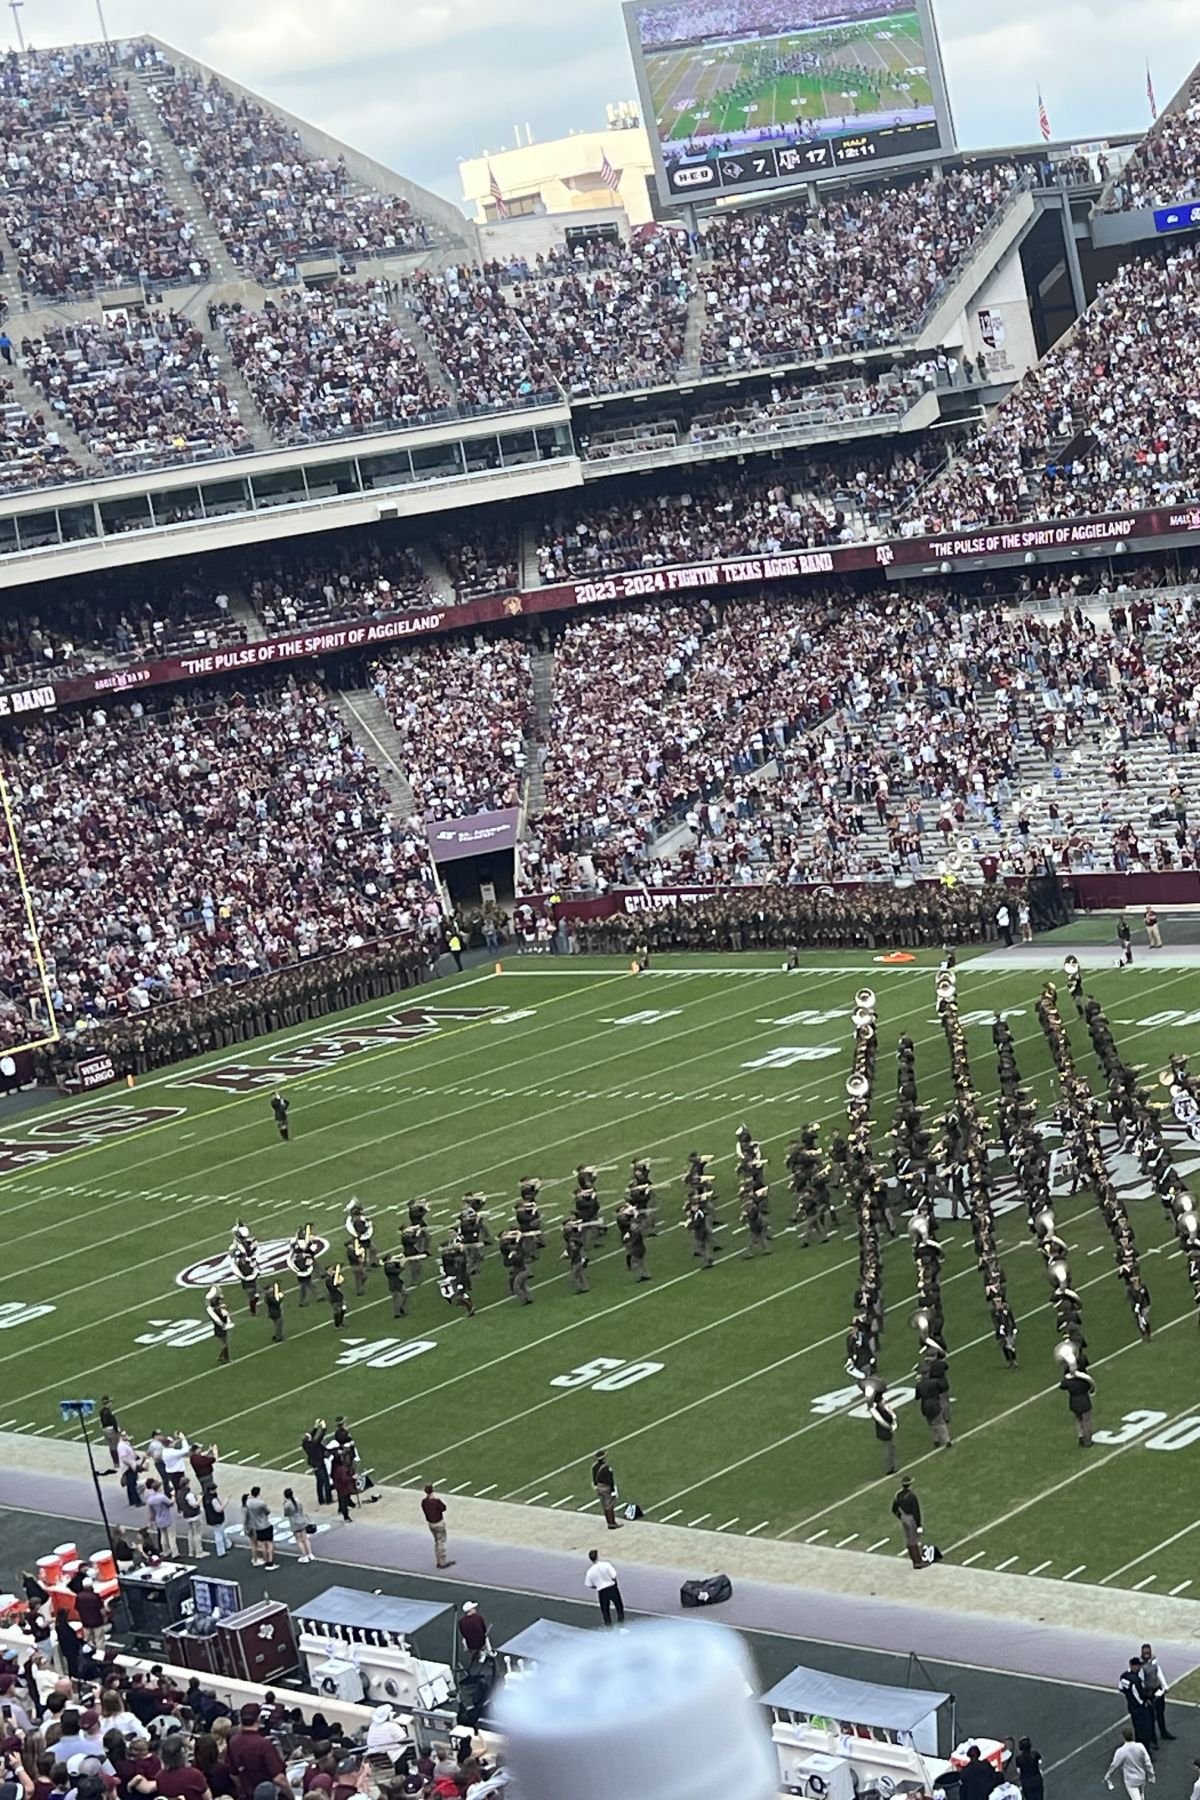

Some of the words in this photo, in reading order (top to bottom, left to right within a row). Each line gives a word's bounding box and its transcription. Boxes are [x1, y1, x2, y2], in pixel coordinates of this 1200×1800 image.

[805, 148, 826, 163] 17
[836, 144, 876, 160] 12:11
[753, 159, 765, 173] 7
[929, 541, 953, 556] "THE
[954, 538, 986, 554] PULSE
[986, 536, 1000, 549] OF
[1001, 533, 1021, 548] THE
[1022, 530, 1054, 547] SPIRIT
[1056, 527, 1070, 541] OF
[1071, 519, 1136, 540] AGGIELAND"
[575, 573, 665, 603] 2023-2024
[721, 559, 763, 583] TEXAS
[763, 556, 799, 579] AGGIE
[799, 552, 833, 574] BAND
[181, 657, 213, 674] "THE
[215, 649, 256, 669] PULSE
[258, 645, 276, 660] OF
[278, 640, 303, 657] THE
[305, 631, 346, 652] SPIRIT
[348, 628, 365, 644] OF
[367, 613, 445, 640] AGGIELAND"
[11, 686, 56, 713] BAND
[81, 1059, 113, 1075] WELLS
[84, 1069, 115, 1086] FARGO
[134, 1318, 216, 1348] 30
[335, 1337, 438, 1369] 40
[549, 1357, 664, 1392] 50
[921, 1545, 935, 1563] 30
